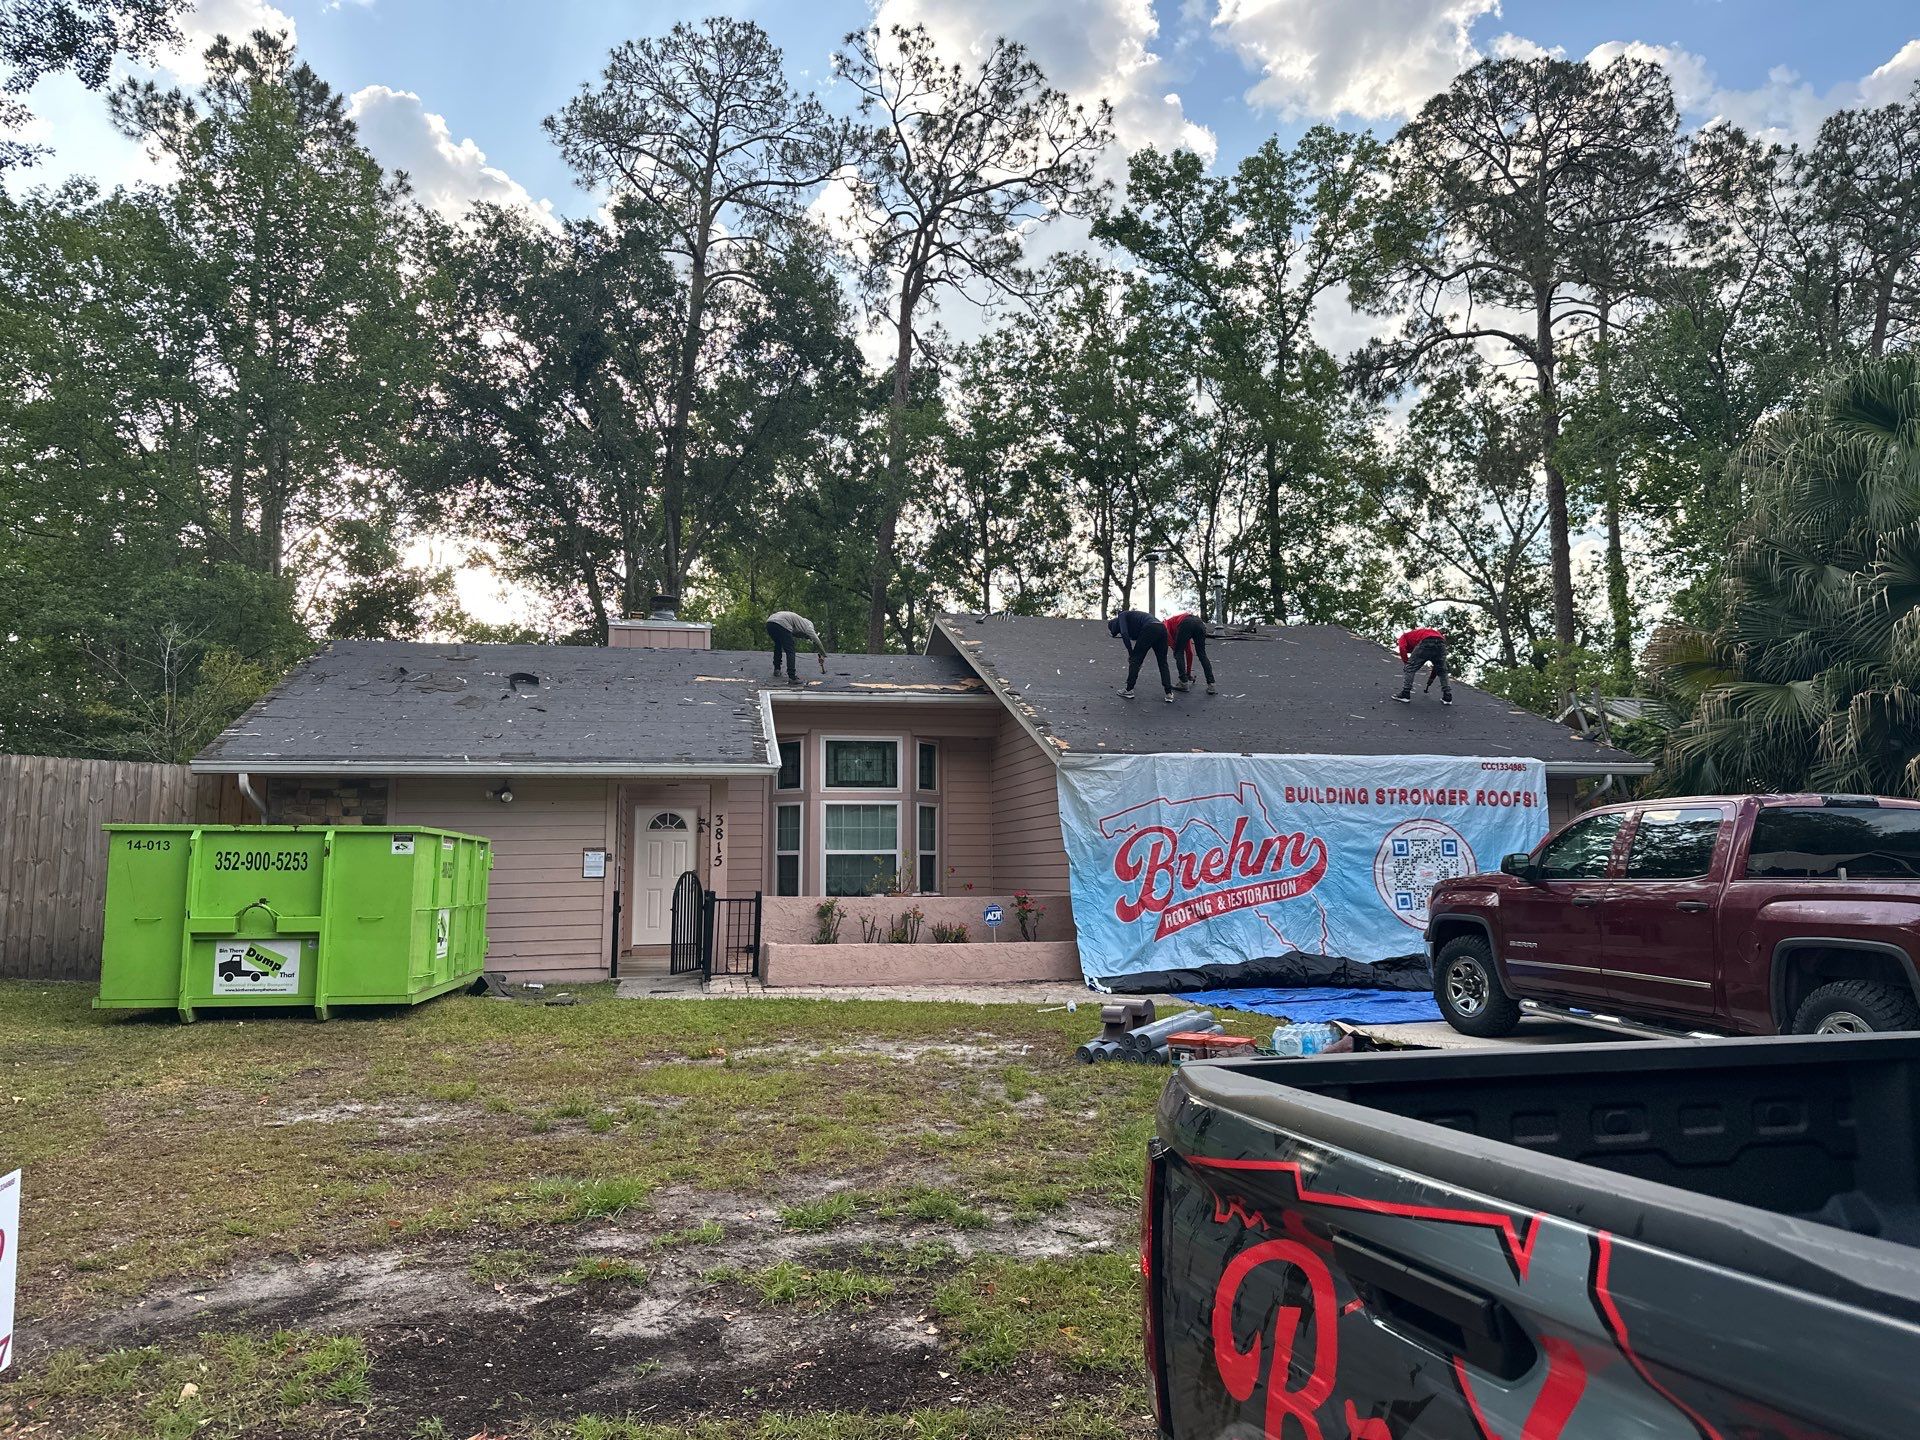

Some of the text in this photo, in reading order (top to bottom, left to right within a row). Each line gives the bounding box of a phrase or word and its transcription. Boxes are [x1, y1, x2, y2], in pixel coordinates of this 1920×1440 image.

[1481, 762, 1527, 772] CCC1334985
[1285, 786, 1538, 807] BUILDING STRONGER ROOFS!
[126, 840, 171, 851] 14-013
[713, 814, 724, 867] 3815
[214, 851, 308, 871] 352-900-5253
[1114, 816, 1326, 923] Brehm
[986, 910, 1002, 921] ADT
[1164, 898, 1213, 929] ROOFING
[1217, 895, 1227, 911] &
[245, 947, 282, 972] Dump
